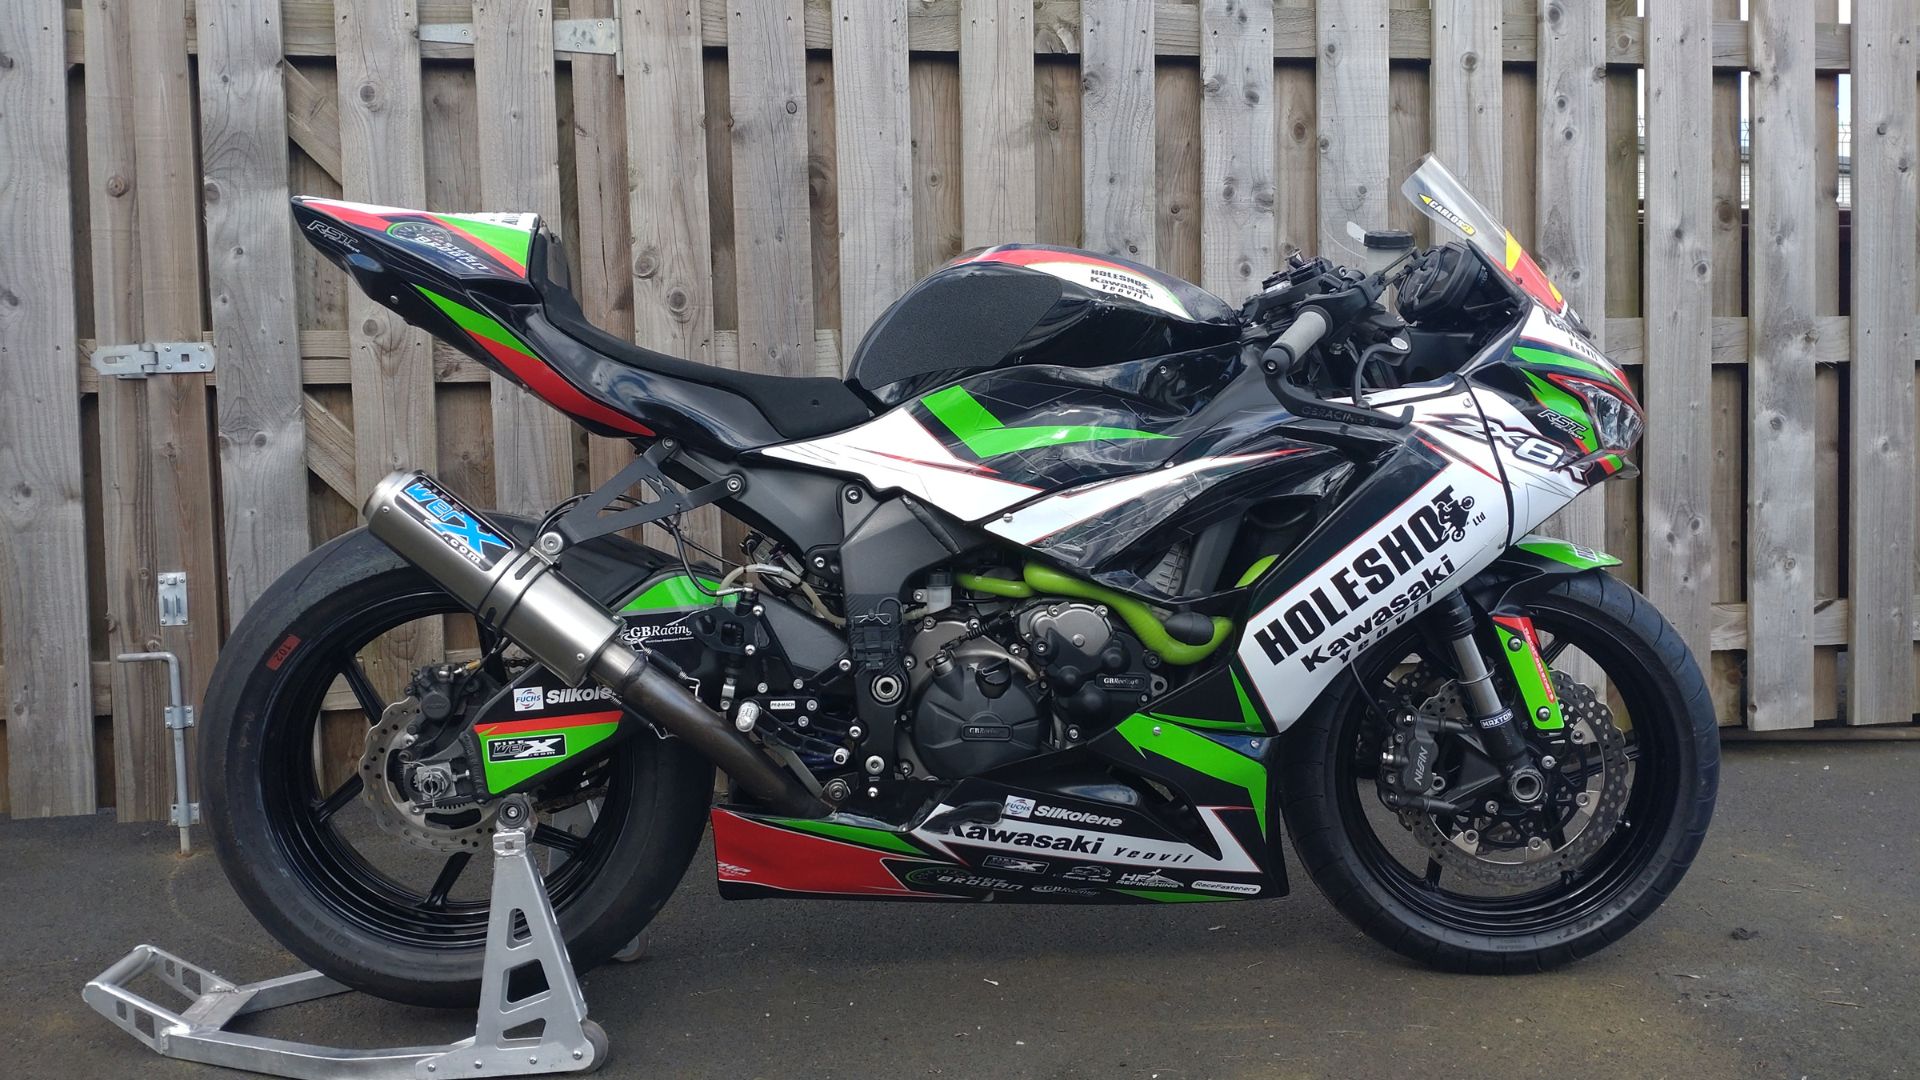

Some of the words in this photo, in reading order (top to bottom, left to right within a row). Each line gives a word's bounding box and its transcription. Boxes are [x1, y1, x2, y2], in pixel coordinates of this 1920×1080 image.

[306, 220, 359, 244] RST
[1090, 276, 1153, 300] Kawasaki
[1537, 409, 1587, 431] RST
[1300, 554, 1456, 673] Kawasaki
[630, 623, 693, 638] GBRacing
[515, 694, 542, 704] FUCHS
[1482, 710, 1513, 728] MAXTON
[1005, 800, 1031, 814] FUCHS
[1033, 804, 1123, 828] Silkolene
[947, 824, 1105, 855] Kawasaki
[1113, 846, 1193, 864] Yeovil
